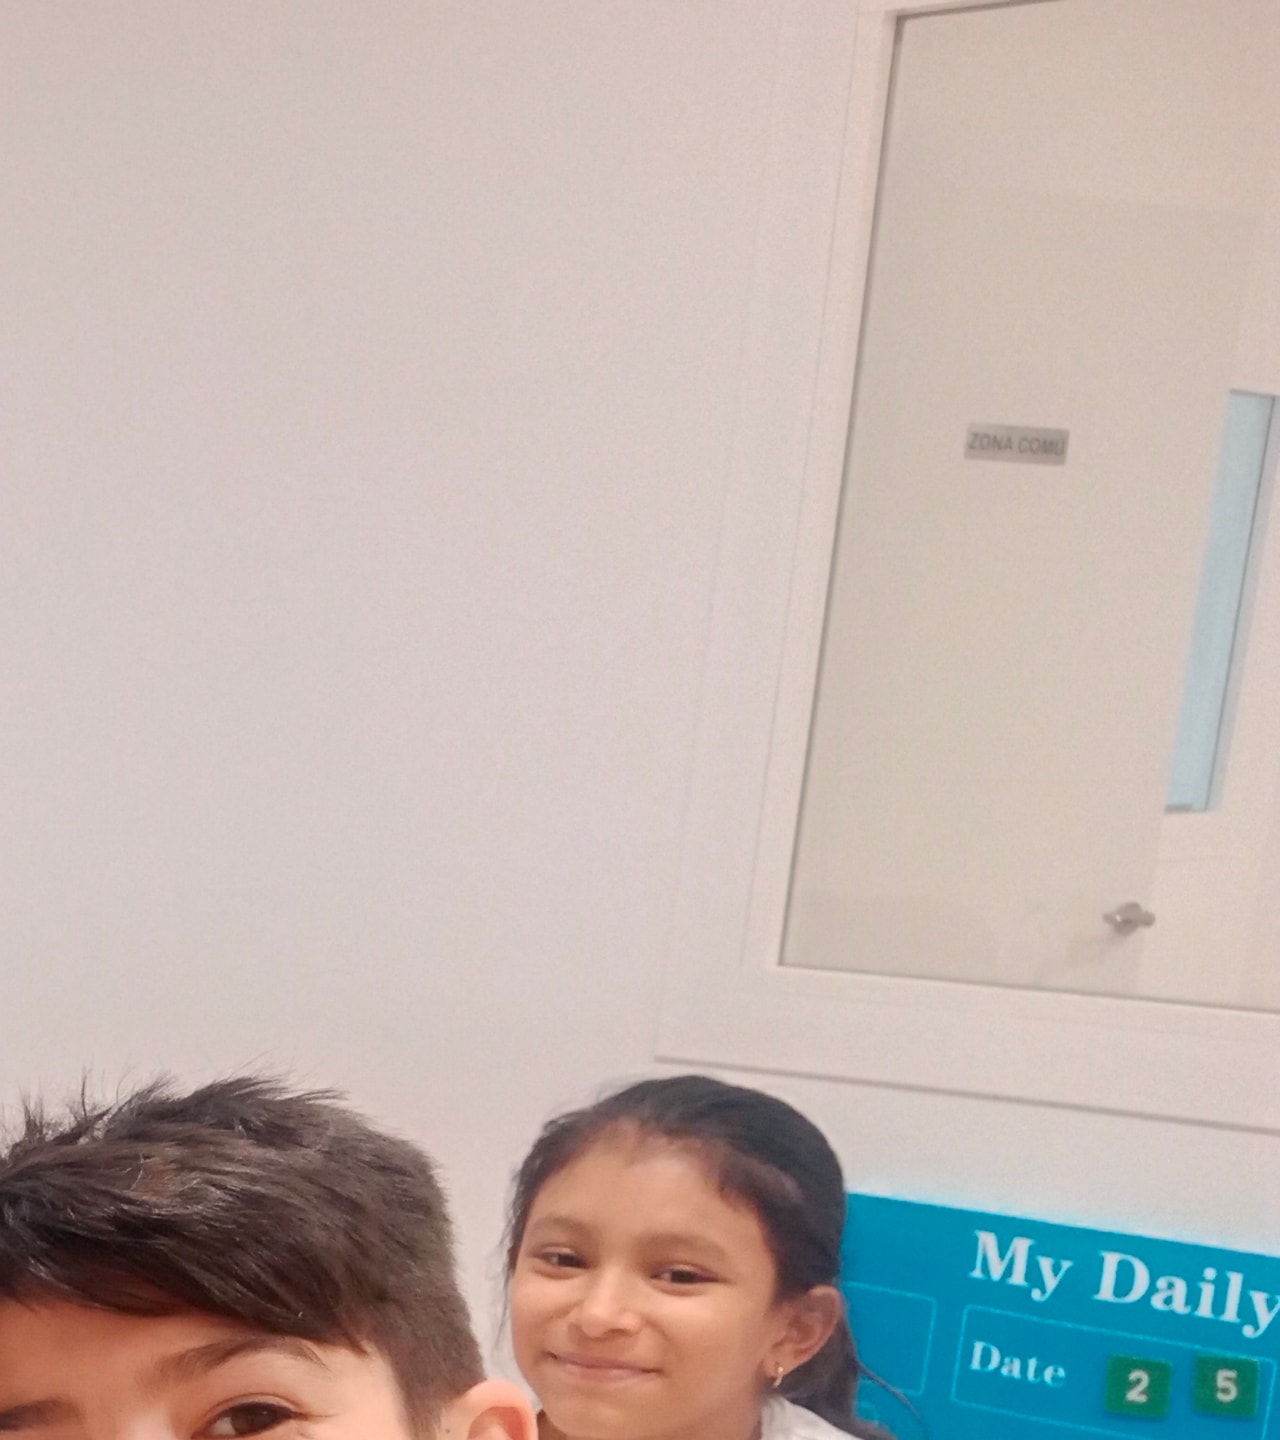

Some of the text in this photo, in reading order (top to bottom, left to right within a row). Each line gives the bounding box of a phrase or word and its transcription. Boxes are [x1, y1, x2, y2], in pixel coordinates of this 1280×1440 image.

[968, 433, 1014, 452] ZONA
[969, 1230, 1280, 1340] My Daily
[970, 1341, 1067, 1388] Date
[1125, 1371, 1238, 1403] 2 5
